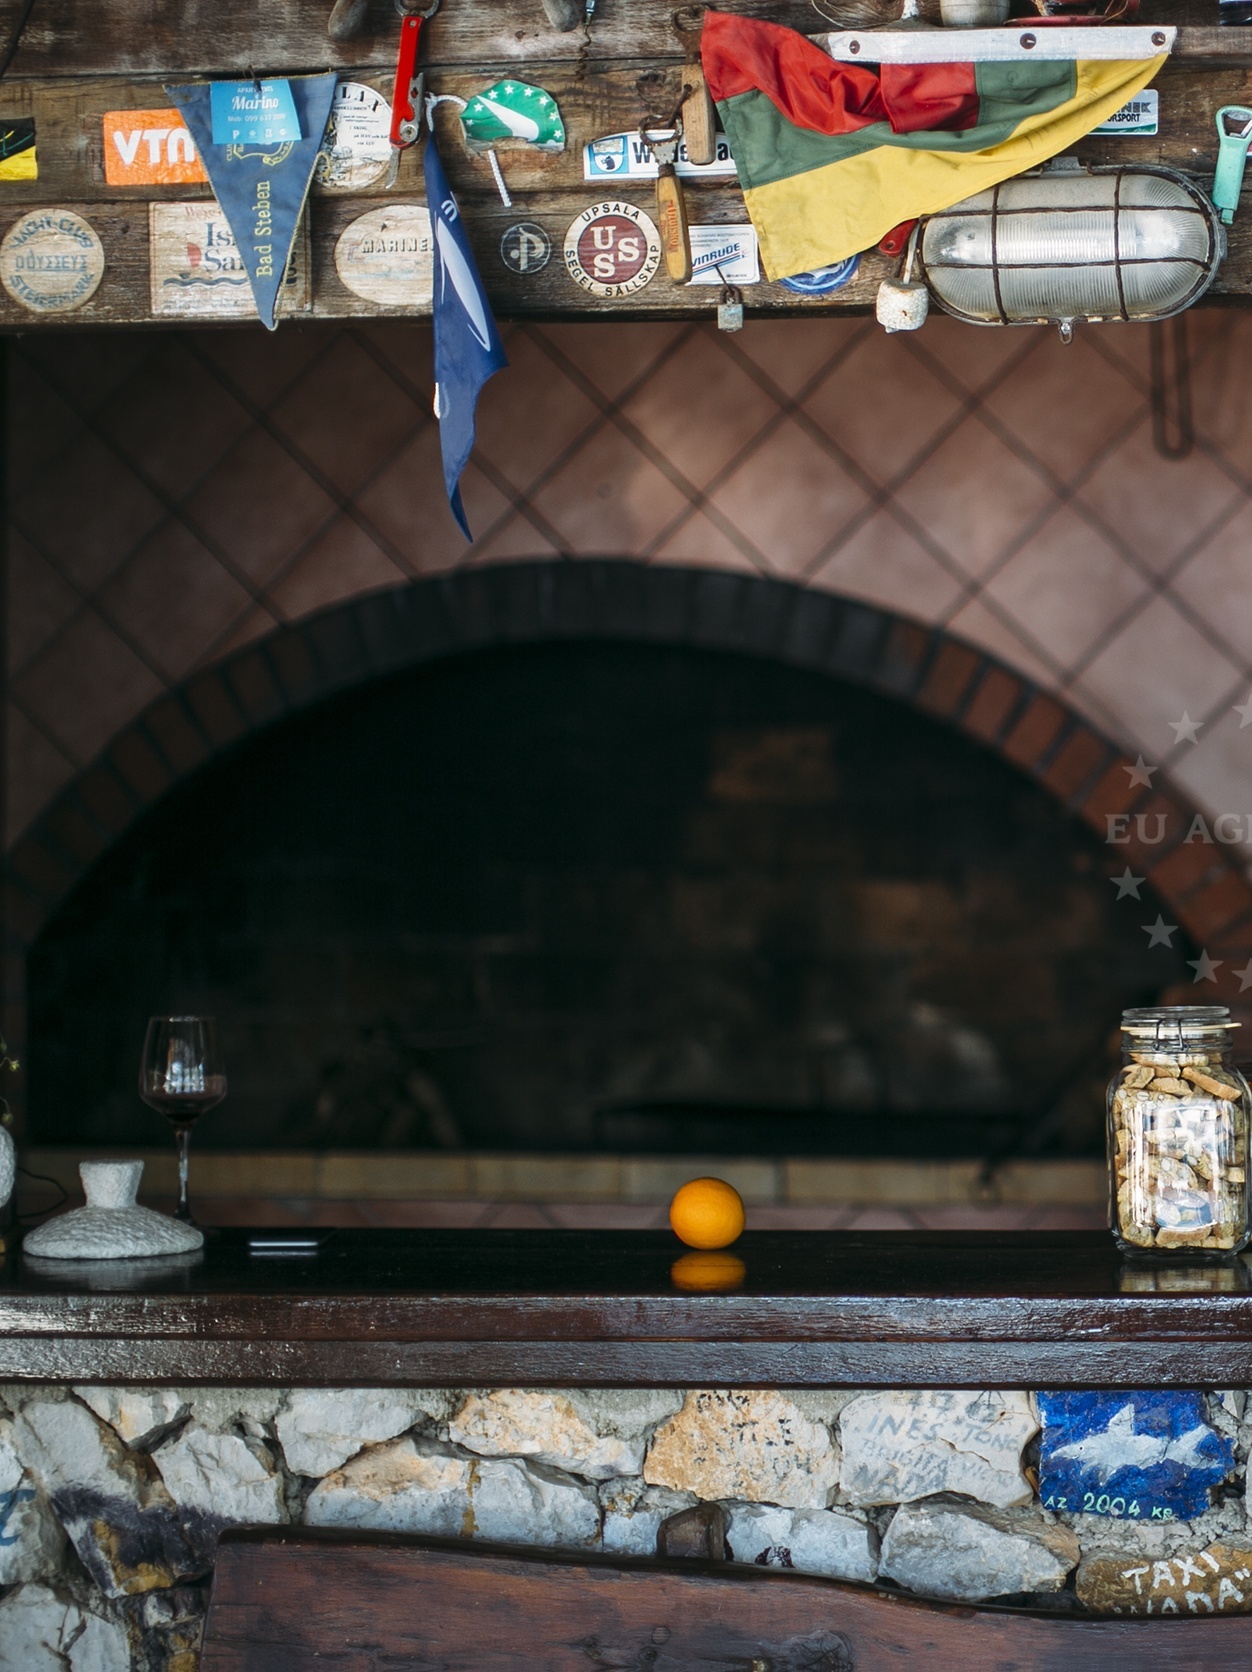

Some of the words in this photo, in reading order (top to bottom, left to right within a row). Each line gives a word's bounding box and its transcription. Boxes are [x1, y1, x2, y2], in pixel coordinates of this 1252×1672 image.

[231, 95, 279, 110] Marino
[252, 180, 272, 236] Steben
[581, 203, 640, 222] UPSALA
[361, 238, 434, 253] MARINE
[692, 242, 741, 266] VINRUDE
[254, 243, 273, 278] Bad
[566, 250, 595, 292] SEGEL
[605, 245, 660, 297] SÄLLSKAP
[866, 1408, 944, 1441] INES
[1044, 1495, 1068, 1509] AZ
[1083, 1492, 1141, 1517] 2004
[1121, 1550, 1220, 1595] TAXI
